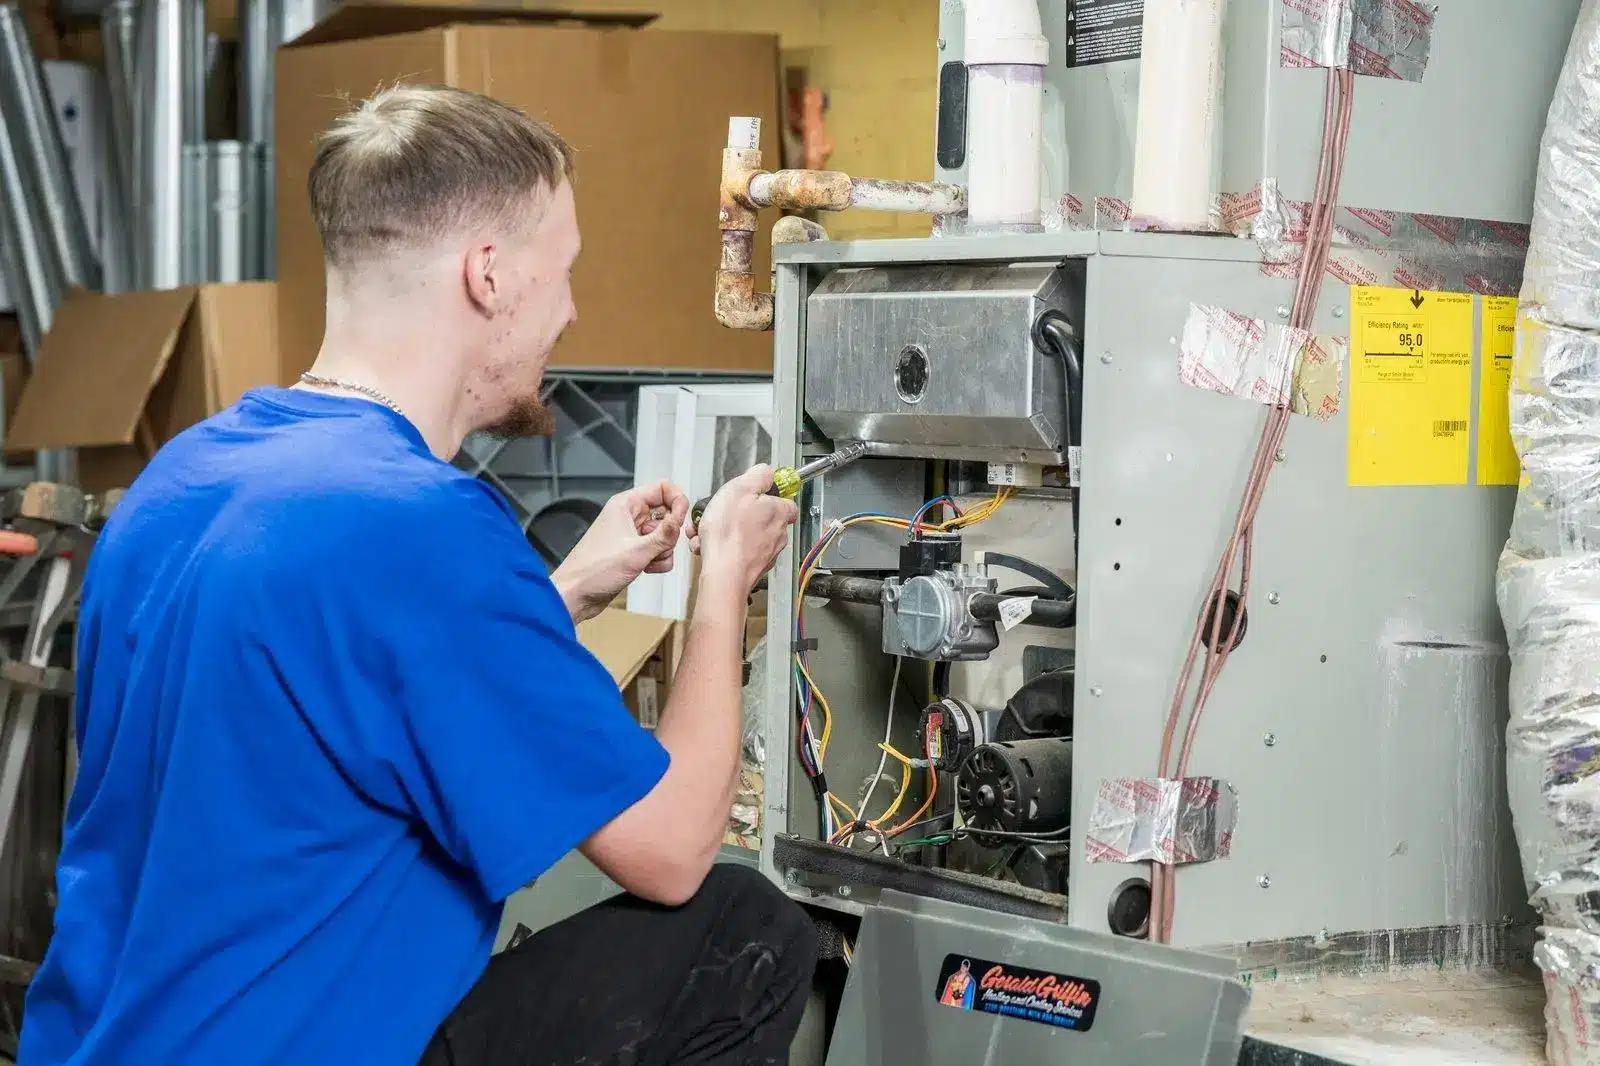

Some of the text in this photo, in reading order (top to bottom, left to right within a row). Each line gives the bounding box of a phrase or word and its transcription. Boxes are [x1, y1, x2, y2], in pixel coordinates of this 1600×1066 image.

[1368, 321, 1391, 330] Efficiency
[1392, 322, 1408, 330] Rating
[1399, 333, 1423, 346] 95.0
[981, 965, 1092, 1007] Gerald Griffin
[1026, 995, 1053, 1013] Cooling
